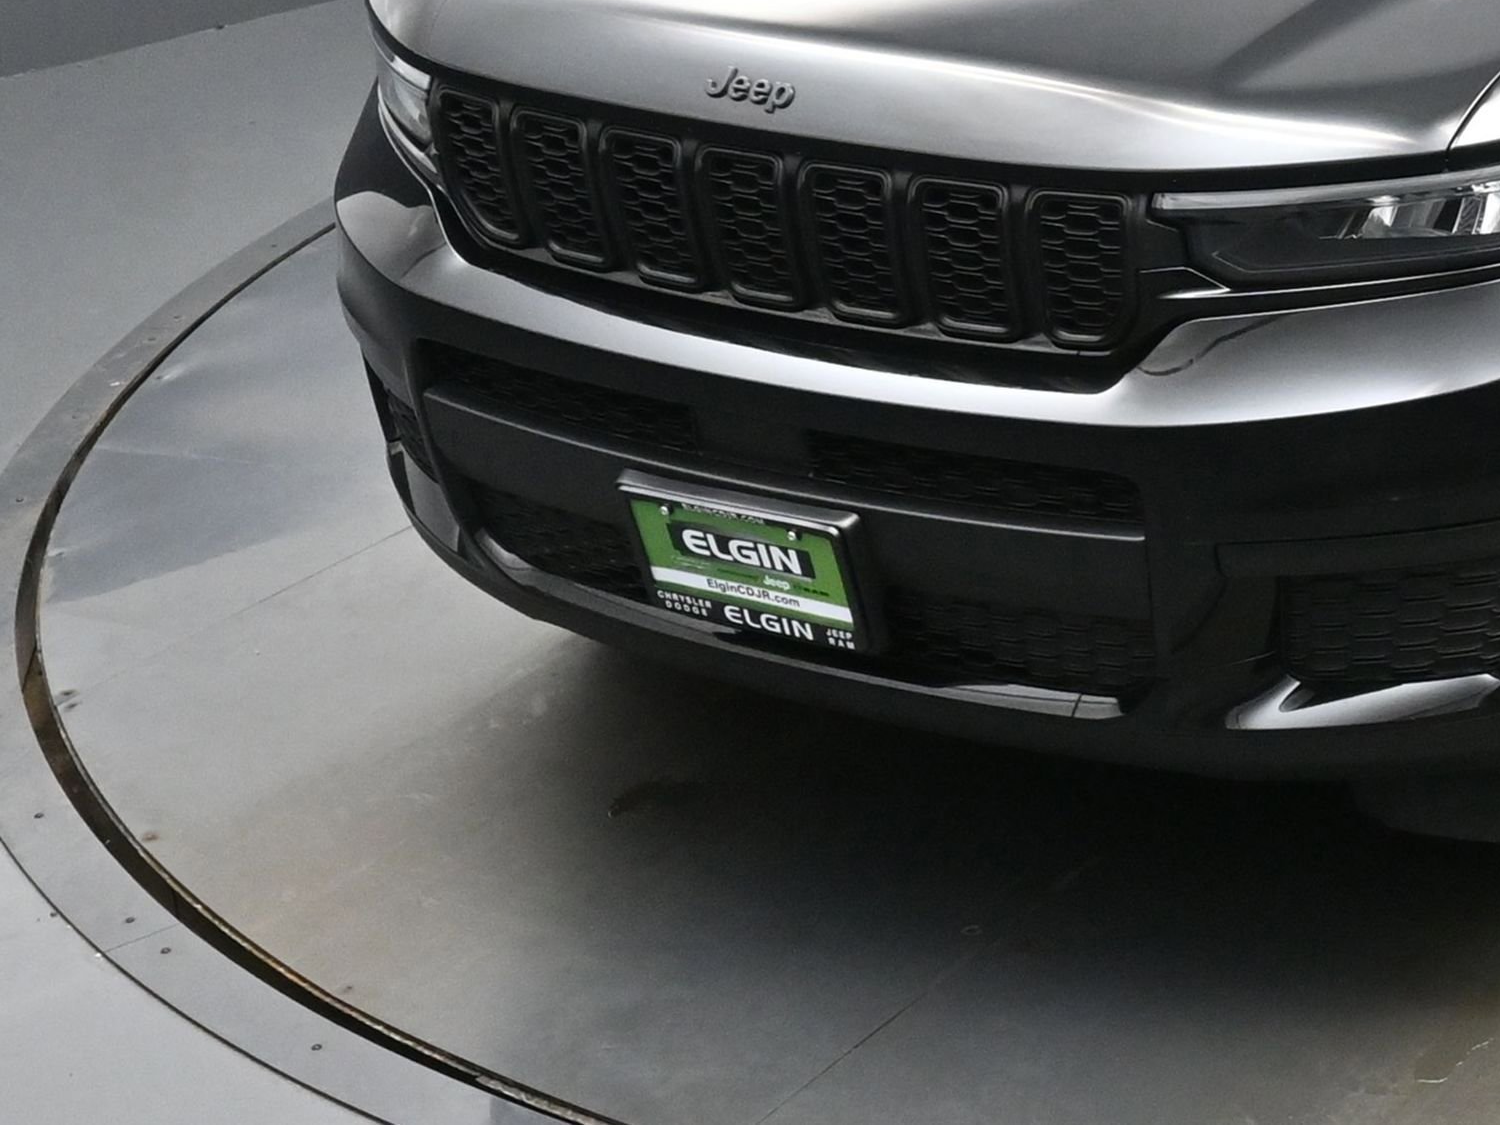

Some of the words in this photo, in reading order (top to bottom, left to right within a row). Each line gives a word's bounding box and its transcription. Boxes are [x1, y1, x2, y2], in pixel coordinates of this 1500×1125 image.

[705, 66, 796, 114] Jeep
[682, 528, 803, 576] ELGIN
[657, 589, 712, 609] CHRYSLER
[706, 578, 801, 608] ElginCDJR.com
[665, 600, 709, 618] DODGE
[723, 605, 815, 641] ELGIN
[826, 628, 853, 640] JEEP
[828, 637, 856, 650] RAM
